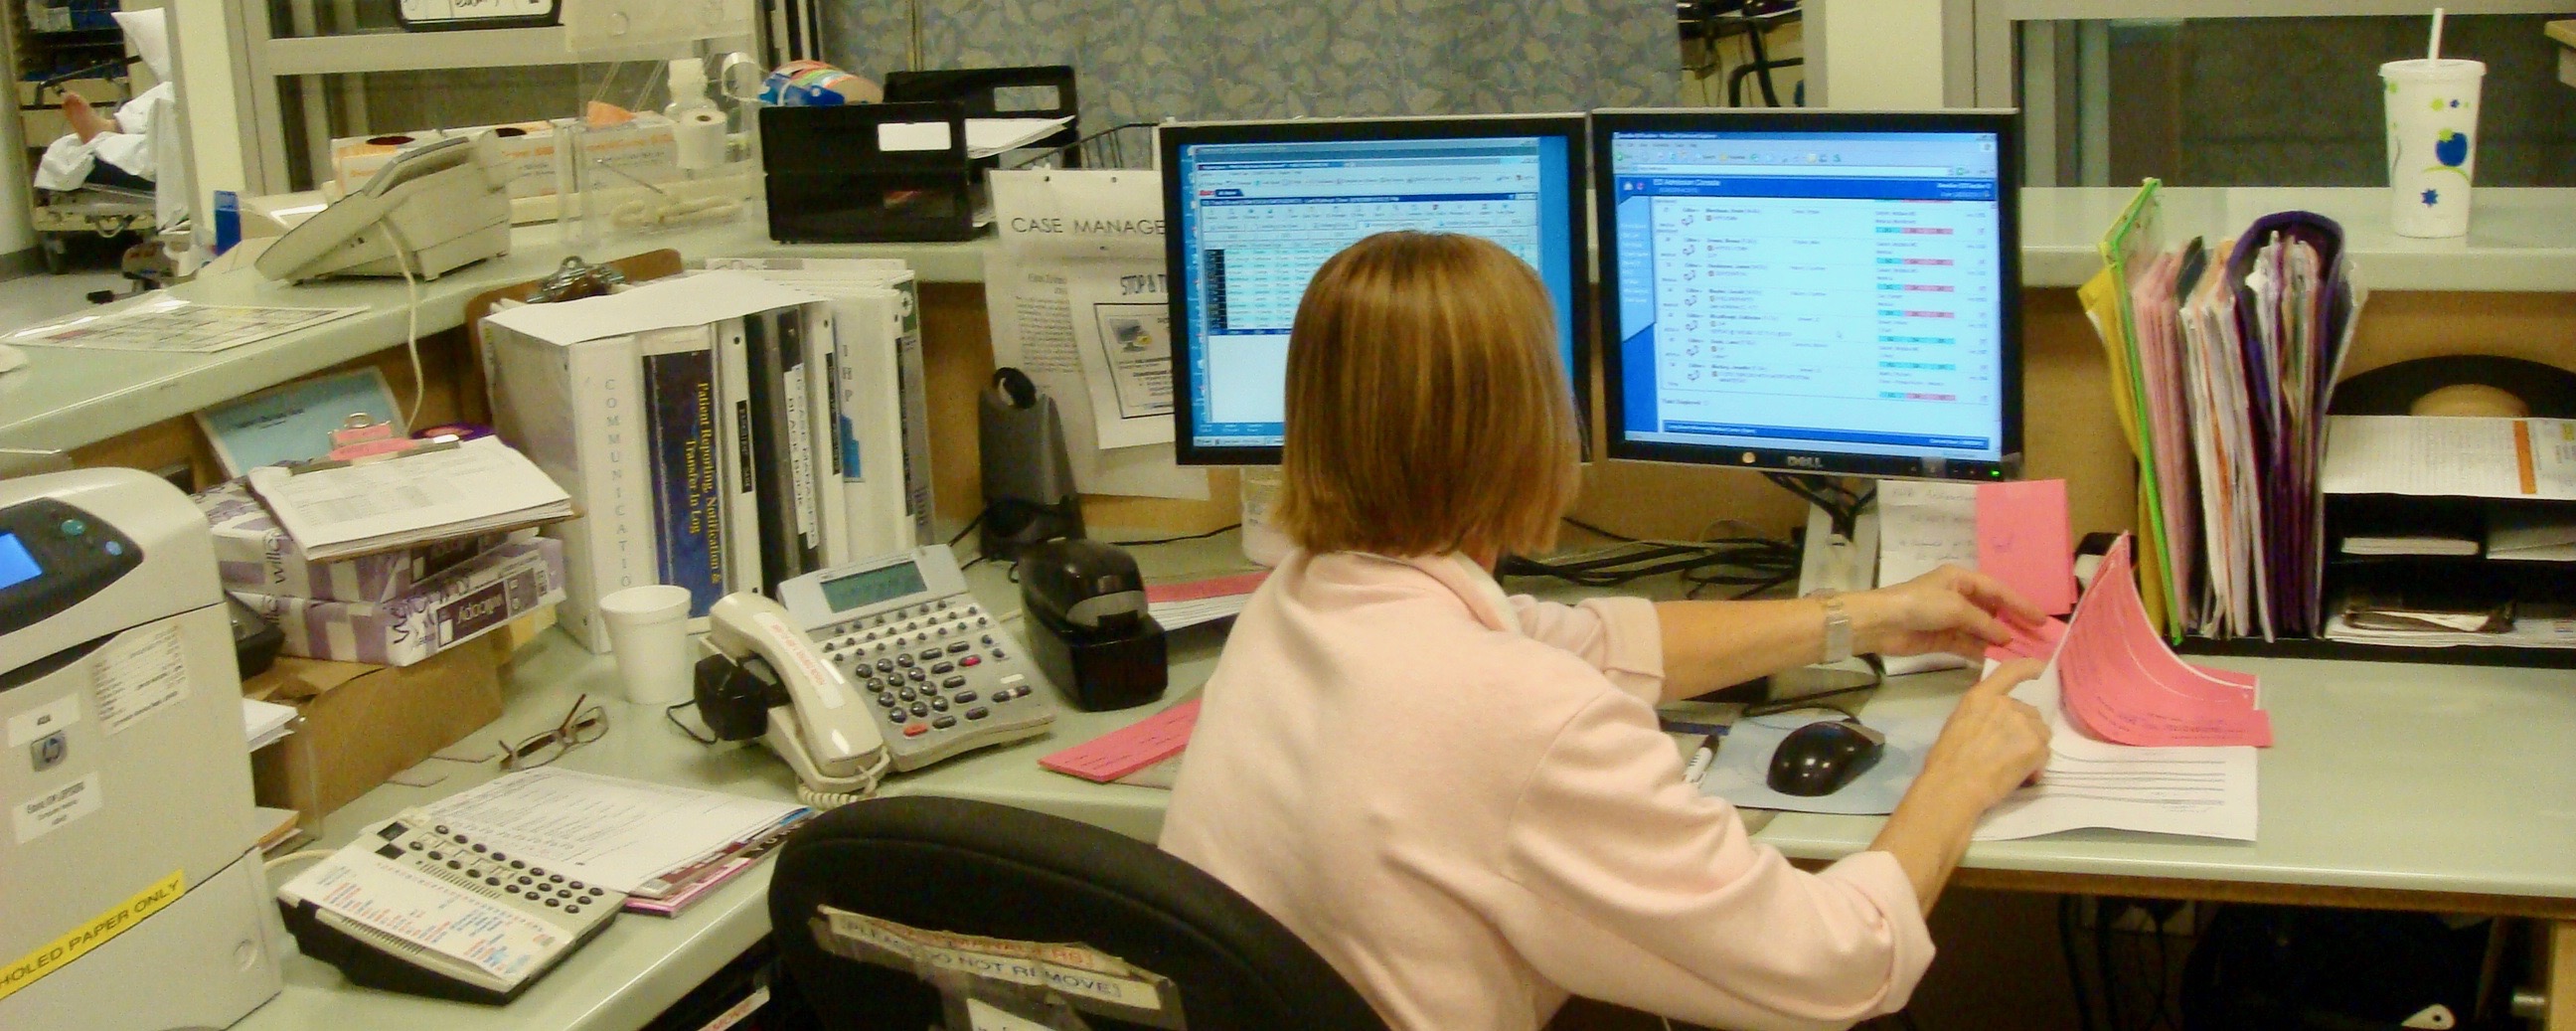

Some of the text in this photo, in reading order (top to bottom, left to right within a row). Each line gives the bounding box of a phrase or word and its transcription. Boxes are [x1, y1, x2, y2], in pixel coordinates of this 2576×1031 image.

[1011, 217, 1166, 236] CASE MANAGE
[1120, 273, 1145, 295] STOP
[1787, 455, 1824, 468] DELL
[685, 439, 702, 535] Transfer In Log
[698, 382, 723, 585] Patient Reporting, Notification &
[0, 879, 179, 985] HOLED PAPER ONLY
[959, 955, 1004, 973] NOT
